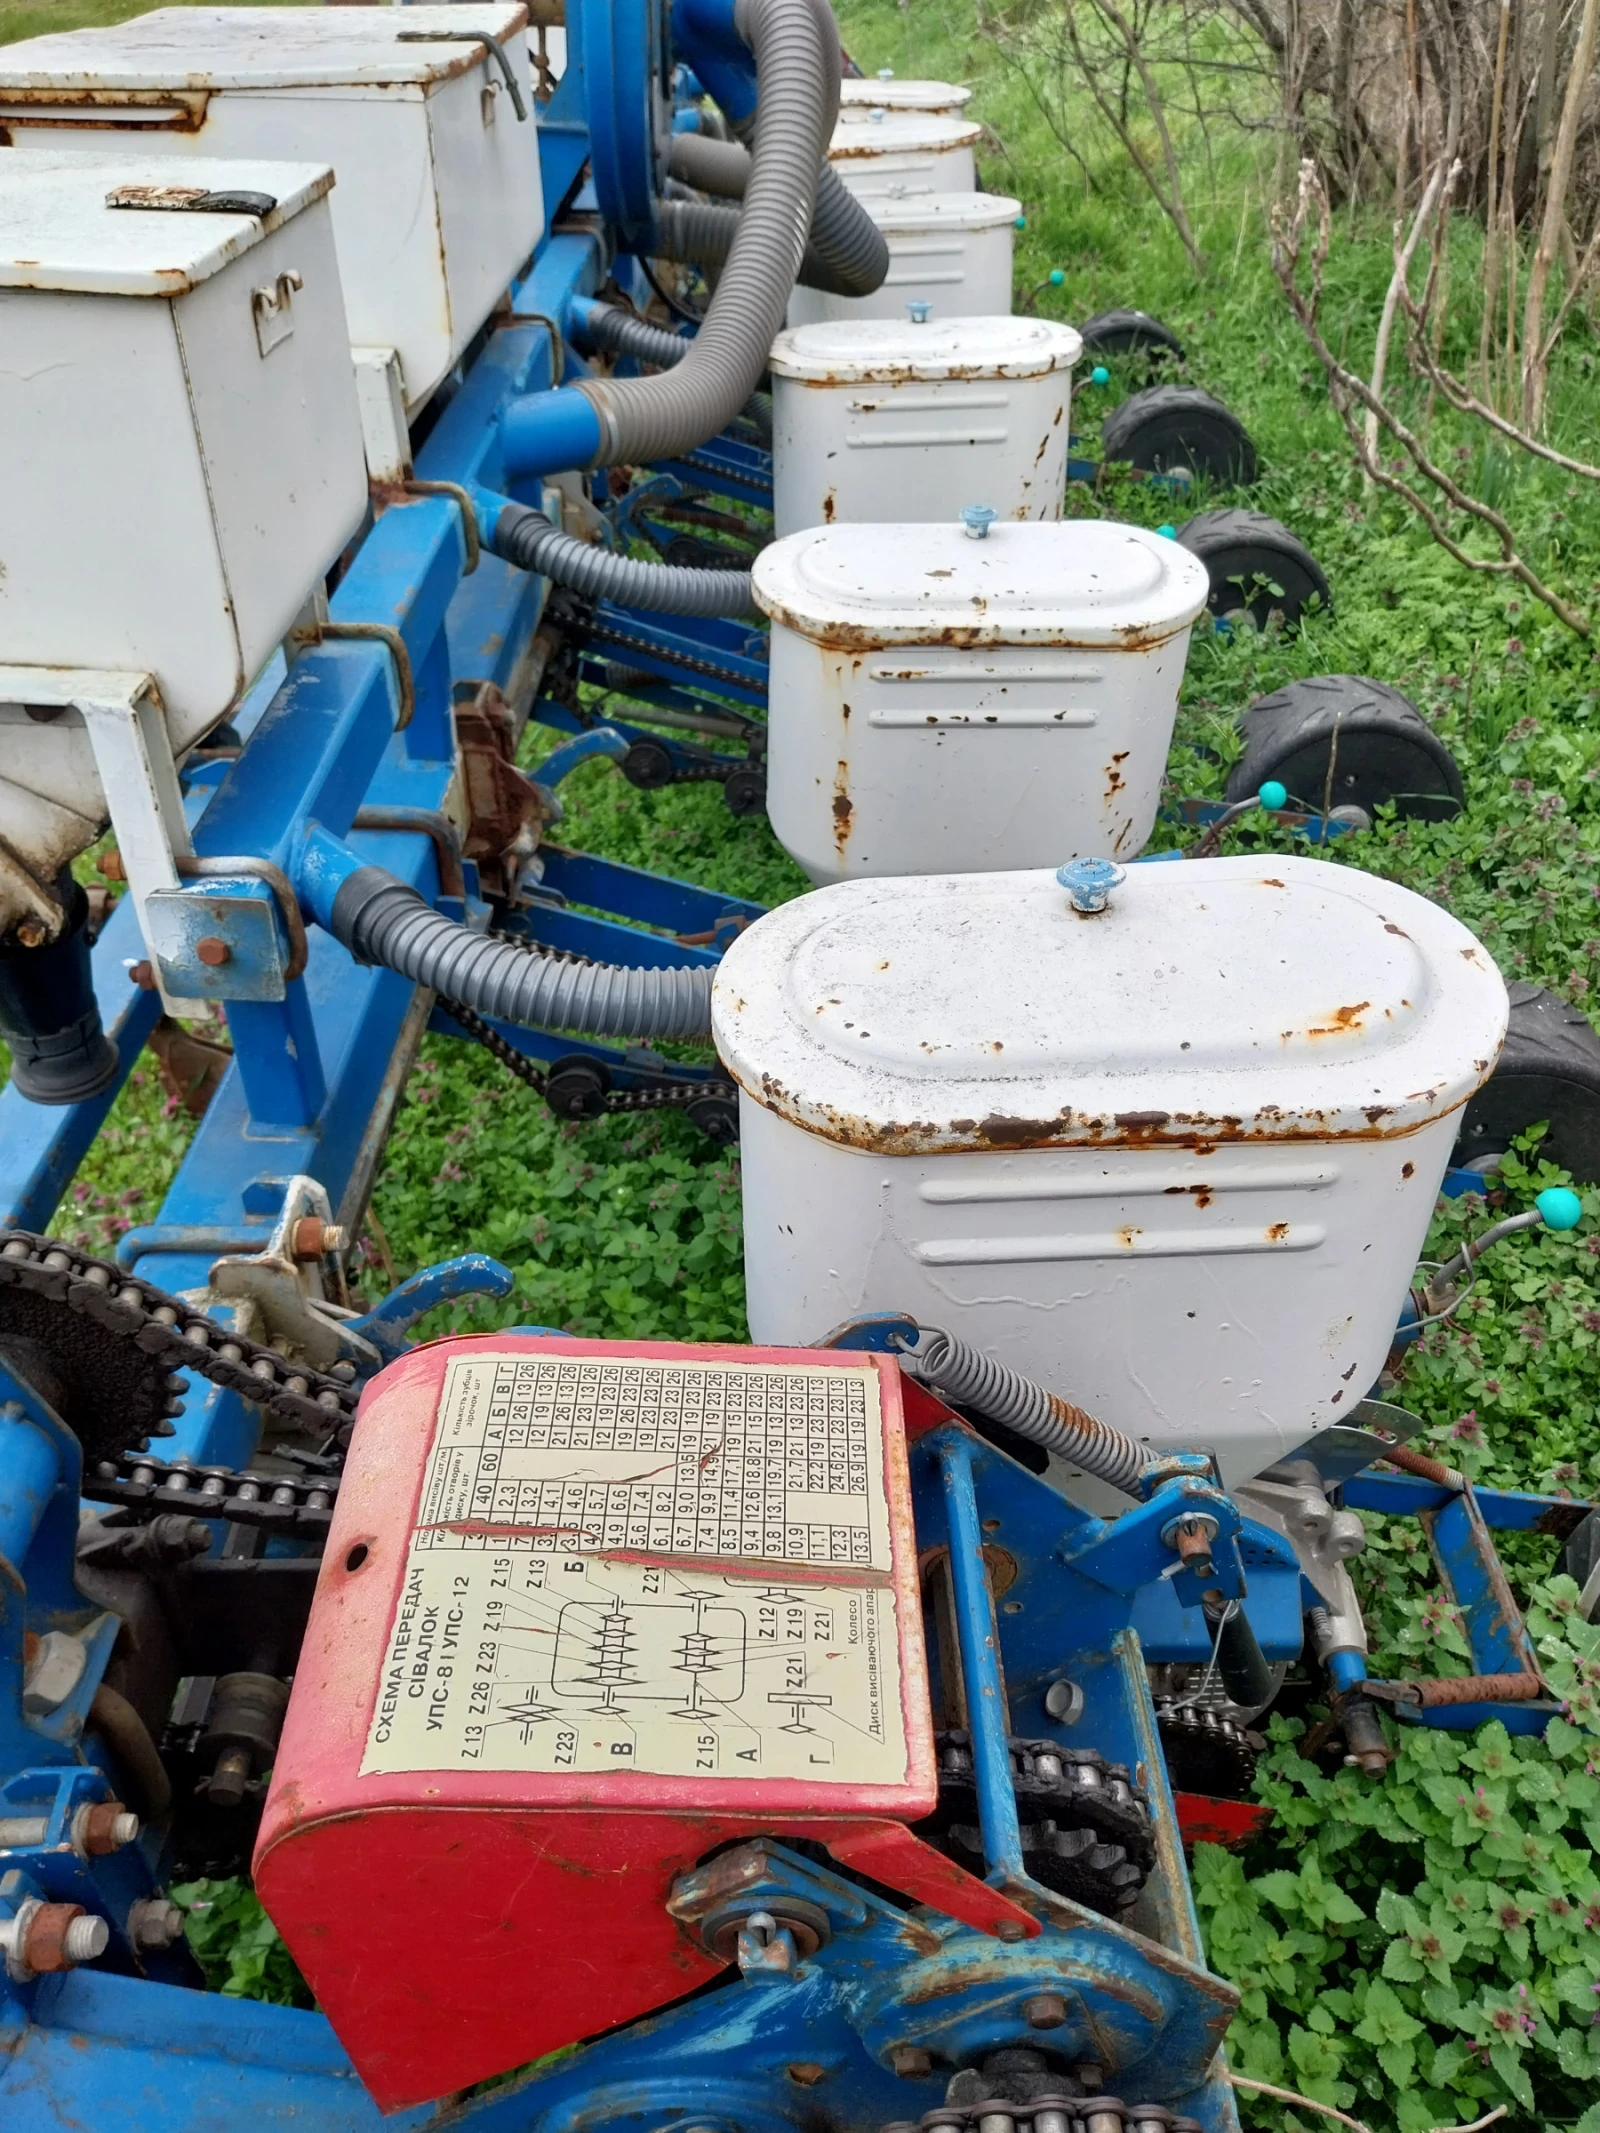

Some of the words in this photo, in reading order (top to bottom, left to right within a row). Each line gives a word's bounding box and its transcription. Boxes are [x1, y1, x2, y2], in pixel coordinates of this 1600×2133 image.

[519, 1365, 535, 1378] 26
[540, 1365, 556, 1378] 26
[561, 1366, 576, 1379] 26
[582, 1367, 598, 1380] 26
[603, 1368, 618, 1381] 26
[624, 1369, 639, 1382] 26
[645, 1370, 660, 1383] 26
[666, 1372, 681, 1384] 26
[688, 1372, 702, 1385] 26
[708, 1374, 722, 1386] 26
[728, 1375, 742, 1387] 26
[749, 1376, 763, 1388] 26
[769, 1377, 783, 1390] 26
[790, 1378, 803, 1390] 26
[810, 1379, 823, 1390] 13
[496, 1385, 510, 1393] В
[516, 1384, 532, 1396] 13
[538, 1384, 552, 1397] 13
[559, 1385, 574, 1397] 13
[580, 1386, 595, 1398] 13
[830, 1380, 843, 1391] 13
[850, 1381, 861, 1392] 13
[601, 1387, 616, 1400] 23
[622, 1388, 637, 1401] 23
[643, 1389, 658, 1402] 23
[664, 1390, 679, 1403] 23
[686, 1391, 700, 1404] 23
[706, 1392, 721, 1405] 23
[727, 1393, 742, 1406] 23
[452, 1396, 467, 1436] Кількість
[462, 1369, 472, 1395] зубців
[748, 1394, 762, 1408] 23
[769, 1396, 783, 1409] 23
[790, 1397, 804, 1410] 23
[810, 1398, 824, 1411] 23
[830, 1399, 844, 1412] 23
[850, 1400, 862, 1413] 23
[491, 1408, 506, 1416] Б
[512, 1405, 528, 1419] 26
[534, 1406, 549, 1419] 19
[555, 1406, 571, 1420] 26
[576, 1407, 592, 1421] 23
[599, 1408, 613, 1421] 19
[619, 1409, 635, 1423] 26
[641, 1410, 656, 1424] 23
[662, 1411, 677, 1425] 23
[684, 1412, 698, 1424] 19
[705, 1413, 719, 1425] 19
[728, 1414, 741, 1427] 15
[748, 1416, 762, 1428] 15
[769, 1416, 783, 1429] 13
[790, 1418, 803, 1430] 13
[810, 1419, 824, 1433] 23
[831, 1420, 844, 1433] 23
[850, 1421, 862, 1434] 19
[488, 1430, 502, 1439] А
[508, 1429, 524, 1443] 12
[530, 1430, 545, 1442] 12
[551, 1432, 567, 1444] 21
[573, 1432, 588, 1445] 21
[596, 1432, 610, 1445] 12
[618, 1432, 632, 1446] 19
[639, 1433, 654, 1446] 19
[660, 1436, 675, 1448] 21
[682, 1435, 696, 1448] 19
[727, 1438, 740, 1451] 19
[747, 1440, 761, 1453] 21
[768, 1440, 782, 1453] 19
[789, 1443, 803, 1456] 21
[810, 1442, 824, 1455] 19
[831, 1445, 845, 1458] 21
[851, 1444, 864, 1458] 19
[481, 1453, 498, 1471] 60
[449, 1458, 461, 1494] отворів
[725, 1459, 740, 1484] 17,1
[746, 1458, 761, 1484] 18,8
[767, 1459, 784, 1485] 19,7
[788, 1460, 806, 1488] 21,7
[810, 1462, 827, 1489] 22,2
[831, 1463, 846, 1490] 24,6
[430, 1477, 442, 1508] висіву
[476, 1485, 492, 1504] 40
[498, 1486, 516, 1506] 2,3
[521, 1487, 539, 1507] 3,2
[544, 1489, 560, 1508] 4,1
[566, 1489, 584, 1508] 4,6
[588, 1489, 605, 1509] 5,7
[455, 1490, 468, 1520] диску,
[611, 1490, 628, 1510] 6,6
[633, 1491, 650, 1511] 7,4
[656, 1492, 673, 1512] 8,2
[678, 1492, 697, 1512] 9,0
[700, 1493, 719, 1513] 9,9
[723, 1490, 741, 1517] 11,4
[745, 1492, 763, 1518] 12,6
[767, 1494, 784, 1519] 13,1
[608, 1524, 626, 1545] 4,9
[653, 1528, 672, 1546] 6,1
[676, 1526, 694, 1547] 6,7
[699, 1528, 717, 1548] 7,4
[722, 1529, 739, 1550] 8,5
[744, 1530, 762, 1550] 9,4
[766, 1531, 784, 1551] 9,8
[788, 1528, 804, 1556] 10,9
[811, 1531, 826, 1557] 11,1
[833, 1530, 850, 1558] 12,3
[564, 1562, 584, 1572] Б
[848, 1600, 858, 1644] Колесо
[375, 1664, 404, 1743] СХЕМА
[392, 1568, 425, 1660] ПЕРЕДАЧ
[408, 1606, 440, 1698] СІВАЛОК
[867, 1618, 878, 1704] висіваючого
[426, 1666, 453, 1730] УПС-8
[869, 1706, 882, 1735] Диск
[610, 1743, 633, 1755] В
[736, 1749, 757, 1762] А
[810, 1754, 830, 1764] Г
